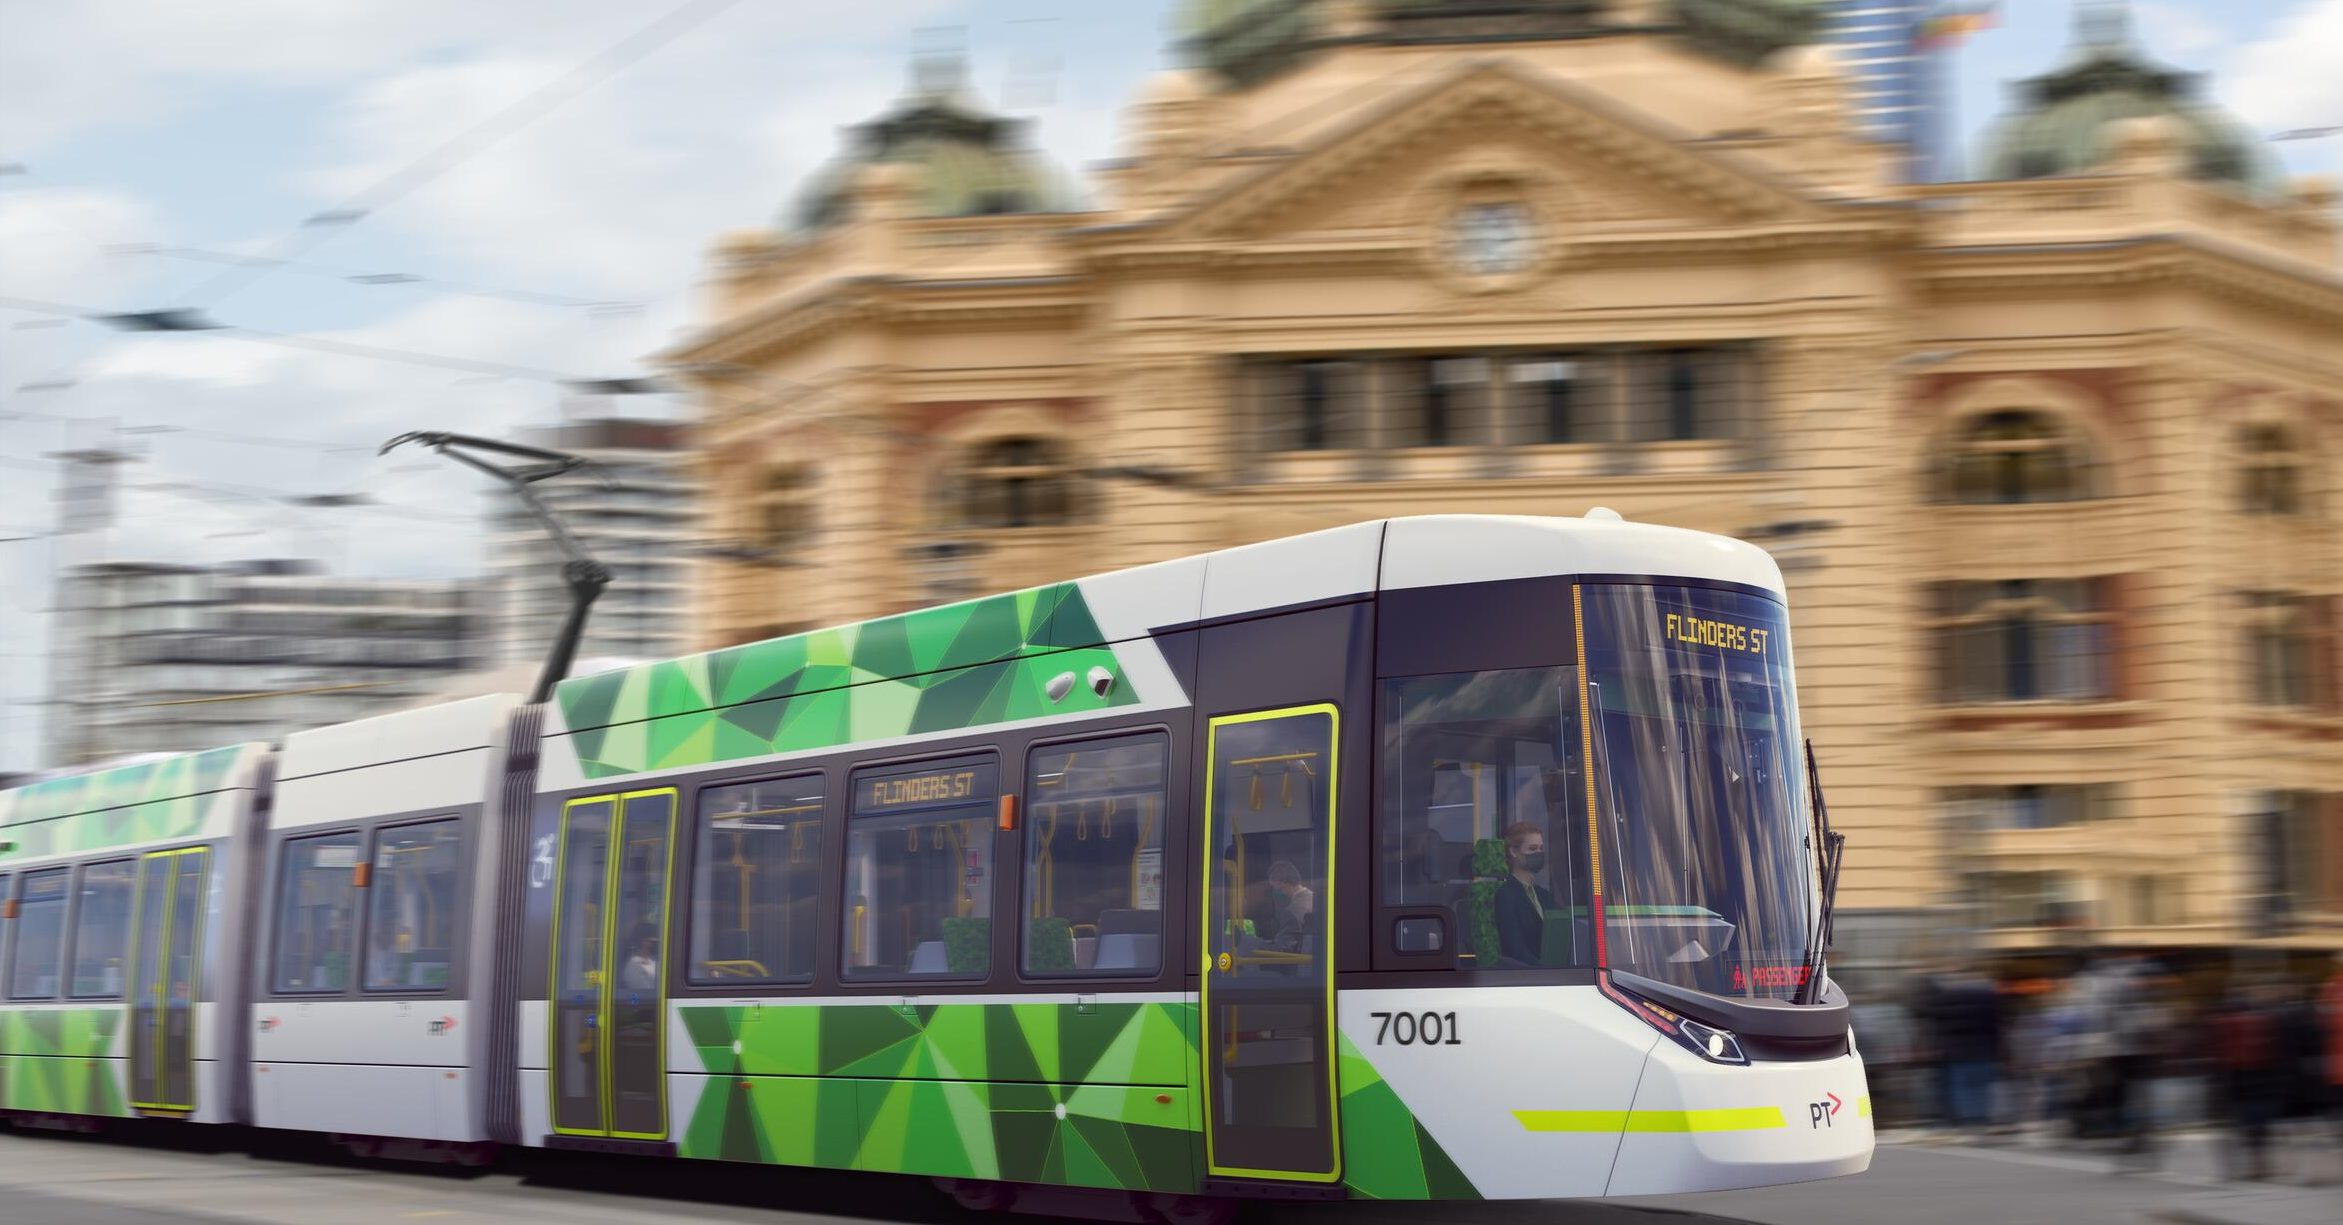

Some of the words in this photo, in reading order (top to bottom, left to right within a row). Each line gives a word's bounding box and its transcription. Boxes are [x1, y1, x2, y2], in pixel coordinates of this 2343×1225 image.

[1666, 613, 1747, 652] FLINDERS
[1750, 628, 1769, 654] ST
[873, 774, 949, 806] FLINDERS
[953, 772, 975, 798] ST
[1370, 1011, 1462, 1046] 7001
[1809, 1101, 1831, 1130] PT
